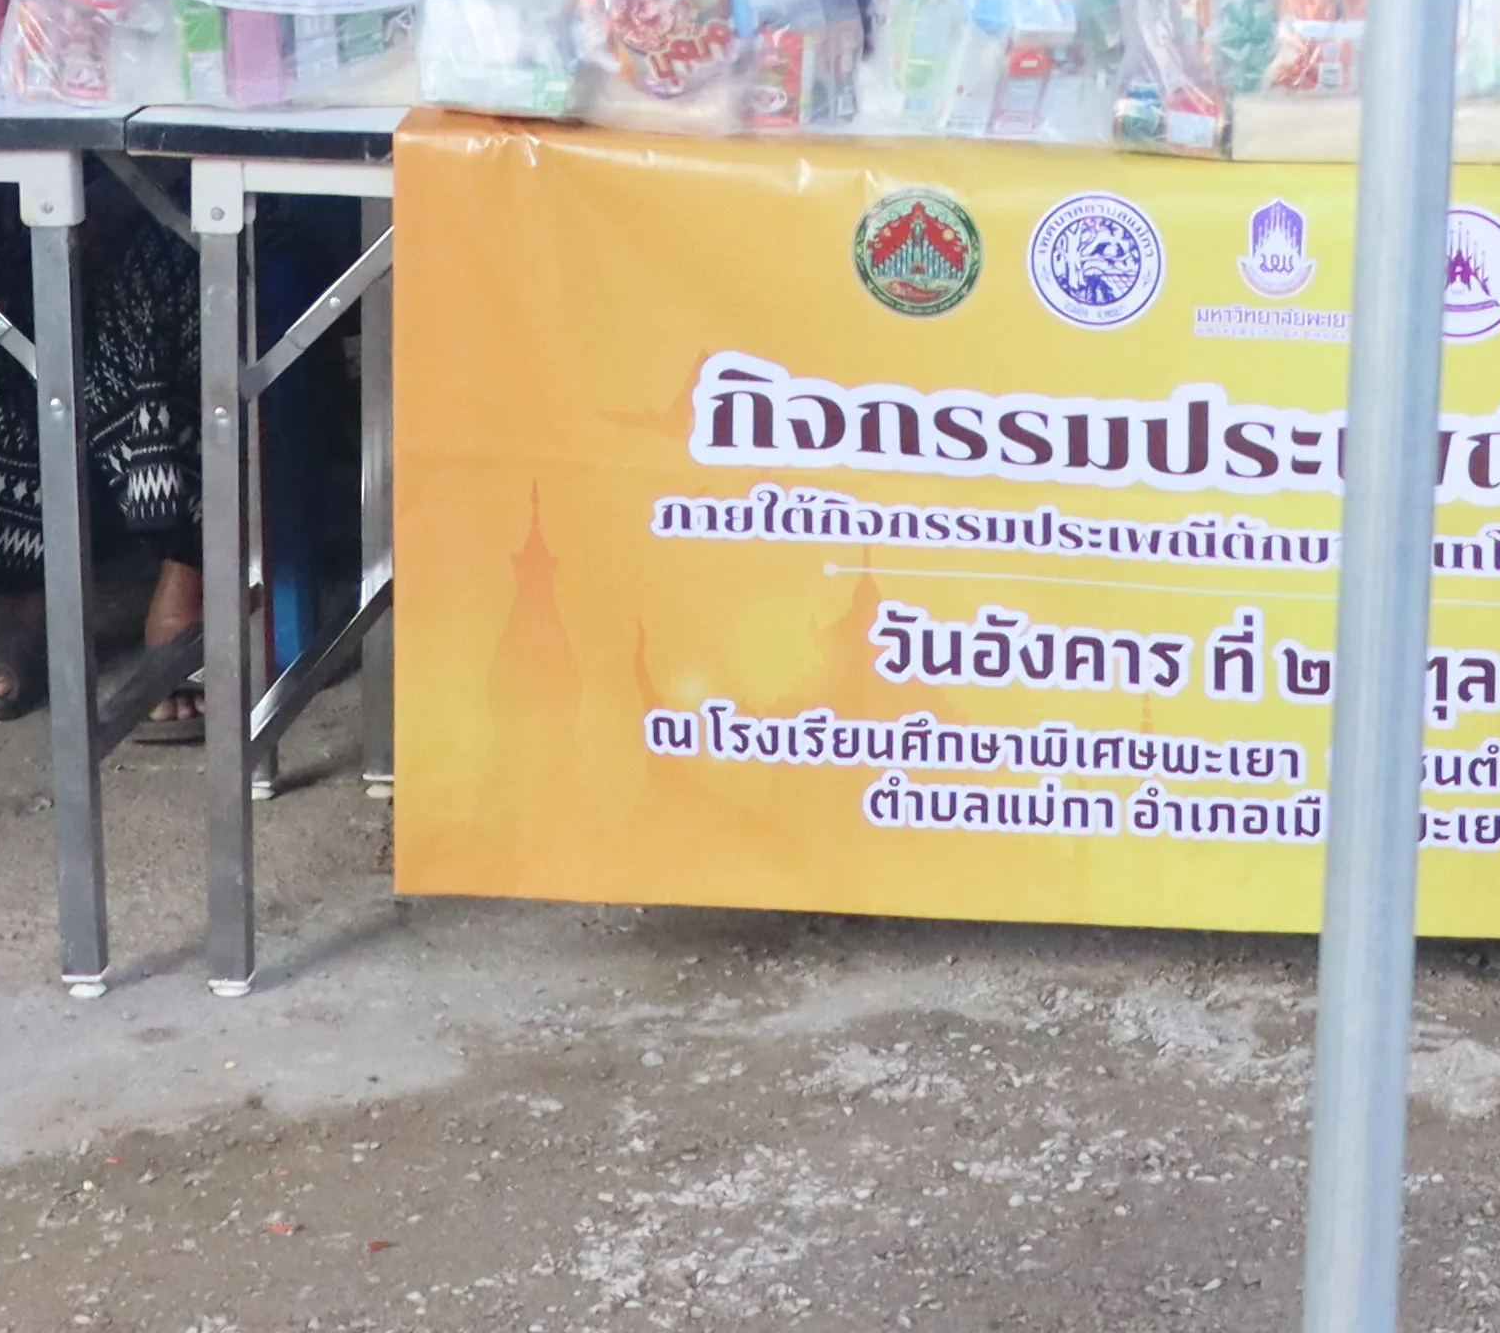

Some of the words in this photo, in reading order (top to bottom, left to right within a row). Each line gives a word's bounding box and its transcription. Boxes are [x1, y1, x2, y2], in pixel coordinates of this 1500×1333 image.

[878, 609, 1185, 688] วันอังคาร
[1213, 614, 1254, 694] ที่
[651, 714, 691, 749] ณ
[708, 705, 1299, 780] โรงเรียนศึกษาพิเศษพะเยา
[870, 776, 1114, 830] ตำบลแม่กา
